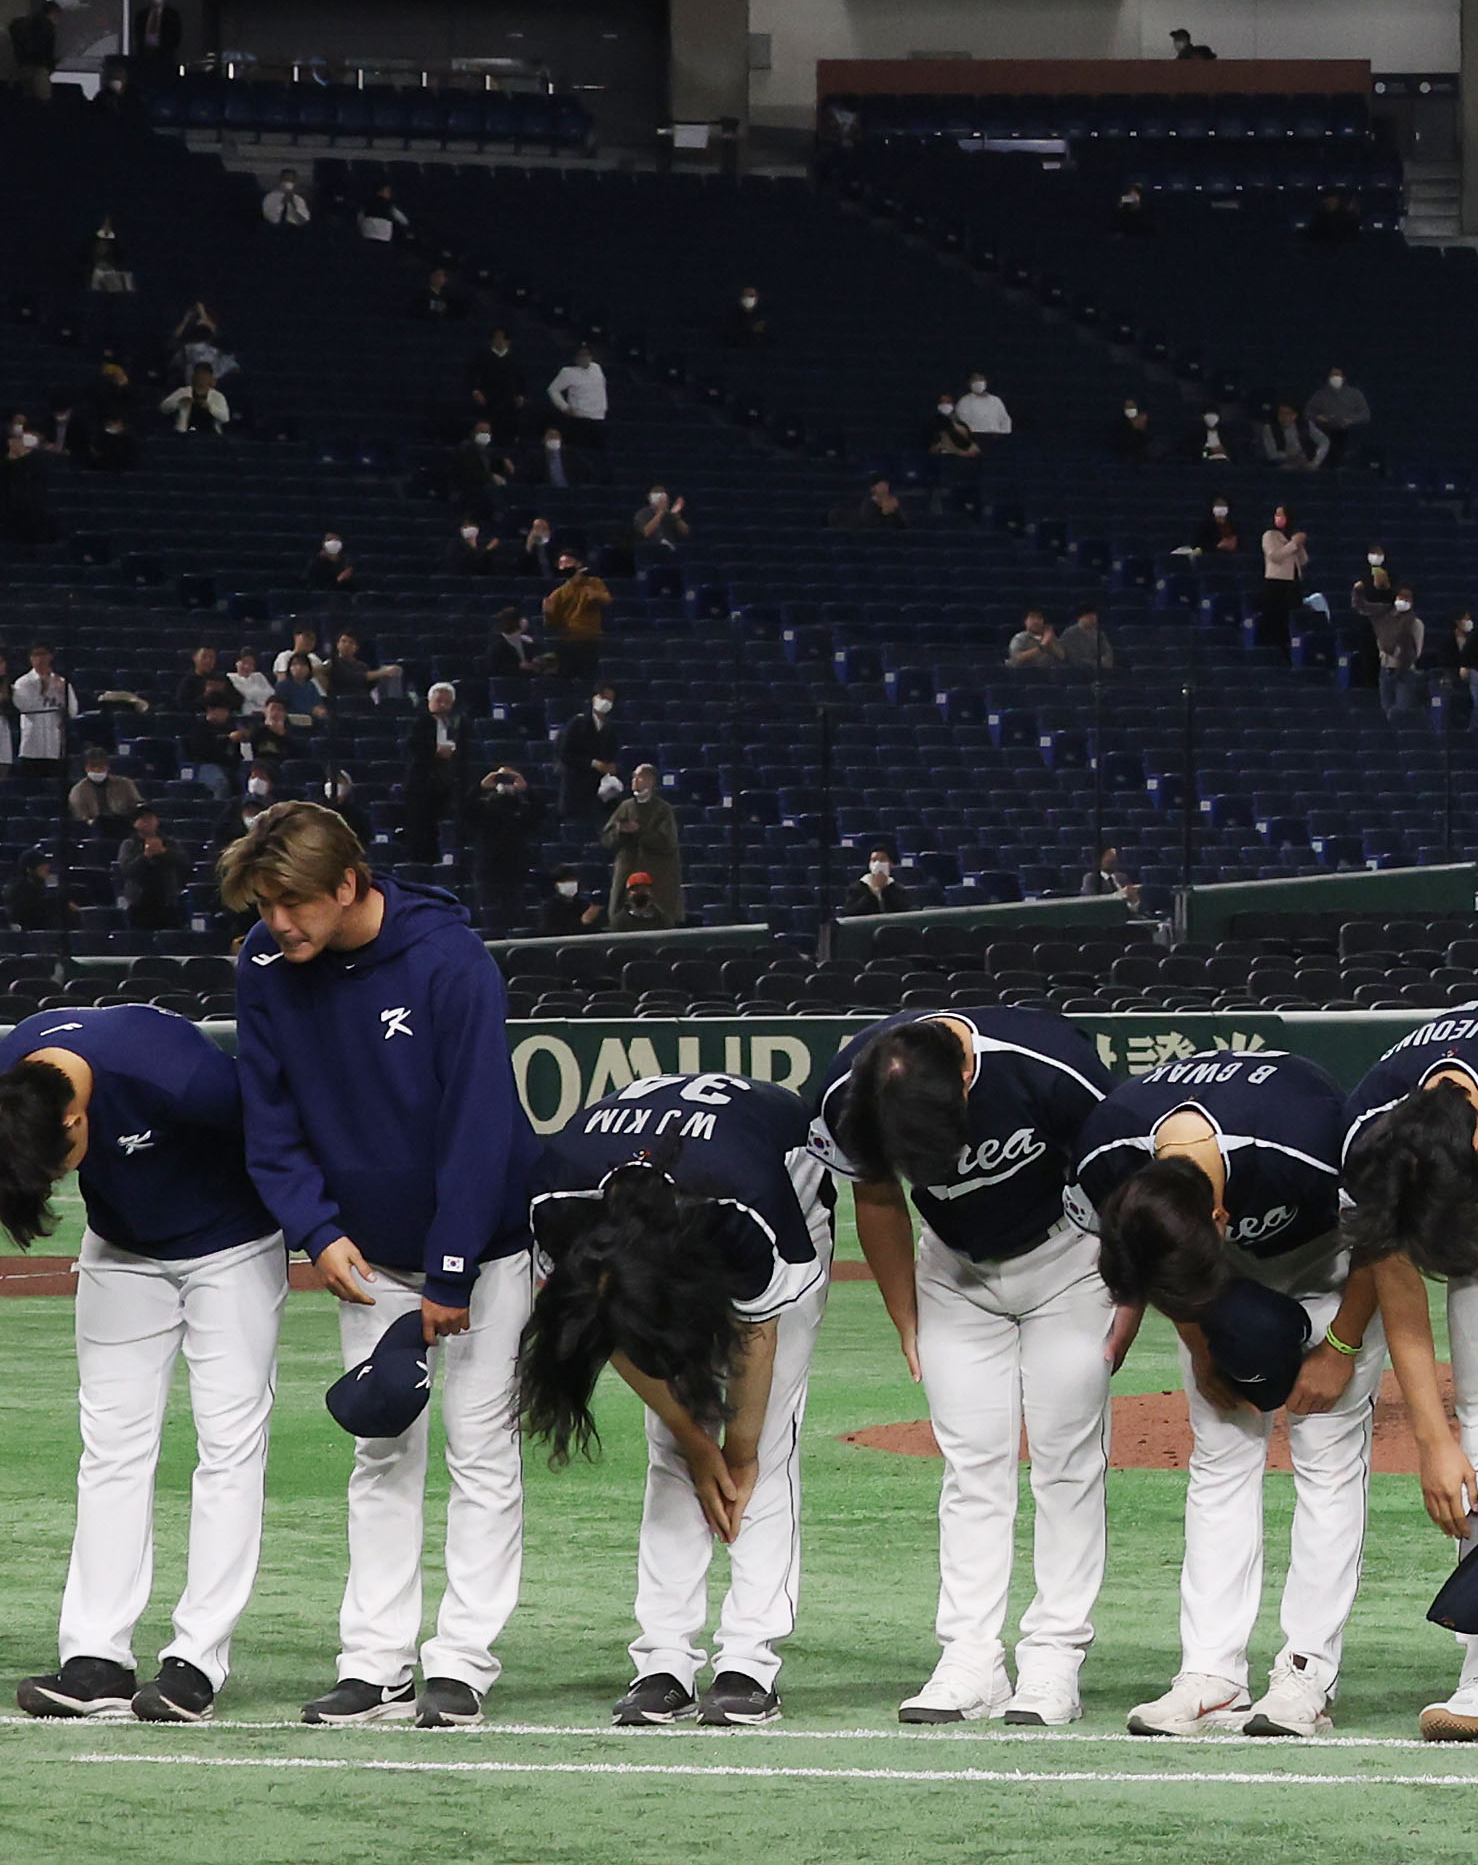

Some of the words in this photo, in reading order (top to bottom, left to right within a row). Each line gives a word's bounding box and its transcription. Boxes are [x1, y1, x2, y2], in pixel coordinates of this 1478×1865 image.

[1247, 1064, 1278, 1084] B
[616, 1072, 751, 1106] 34
[584, 1107, 653, 1135] KIM
[656, 1109, 682, 1135] J
[681, 1111, 718, 1140] W
